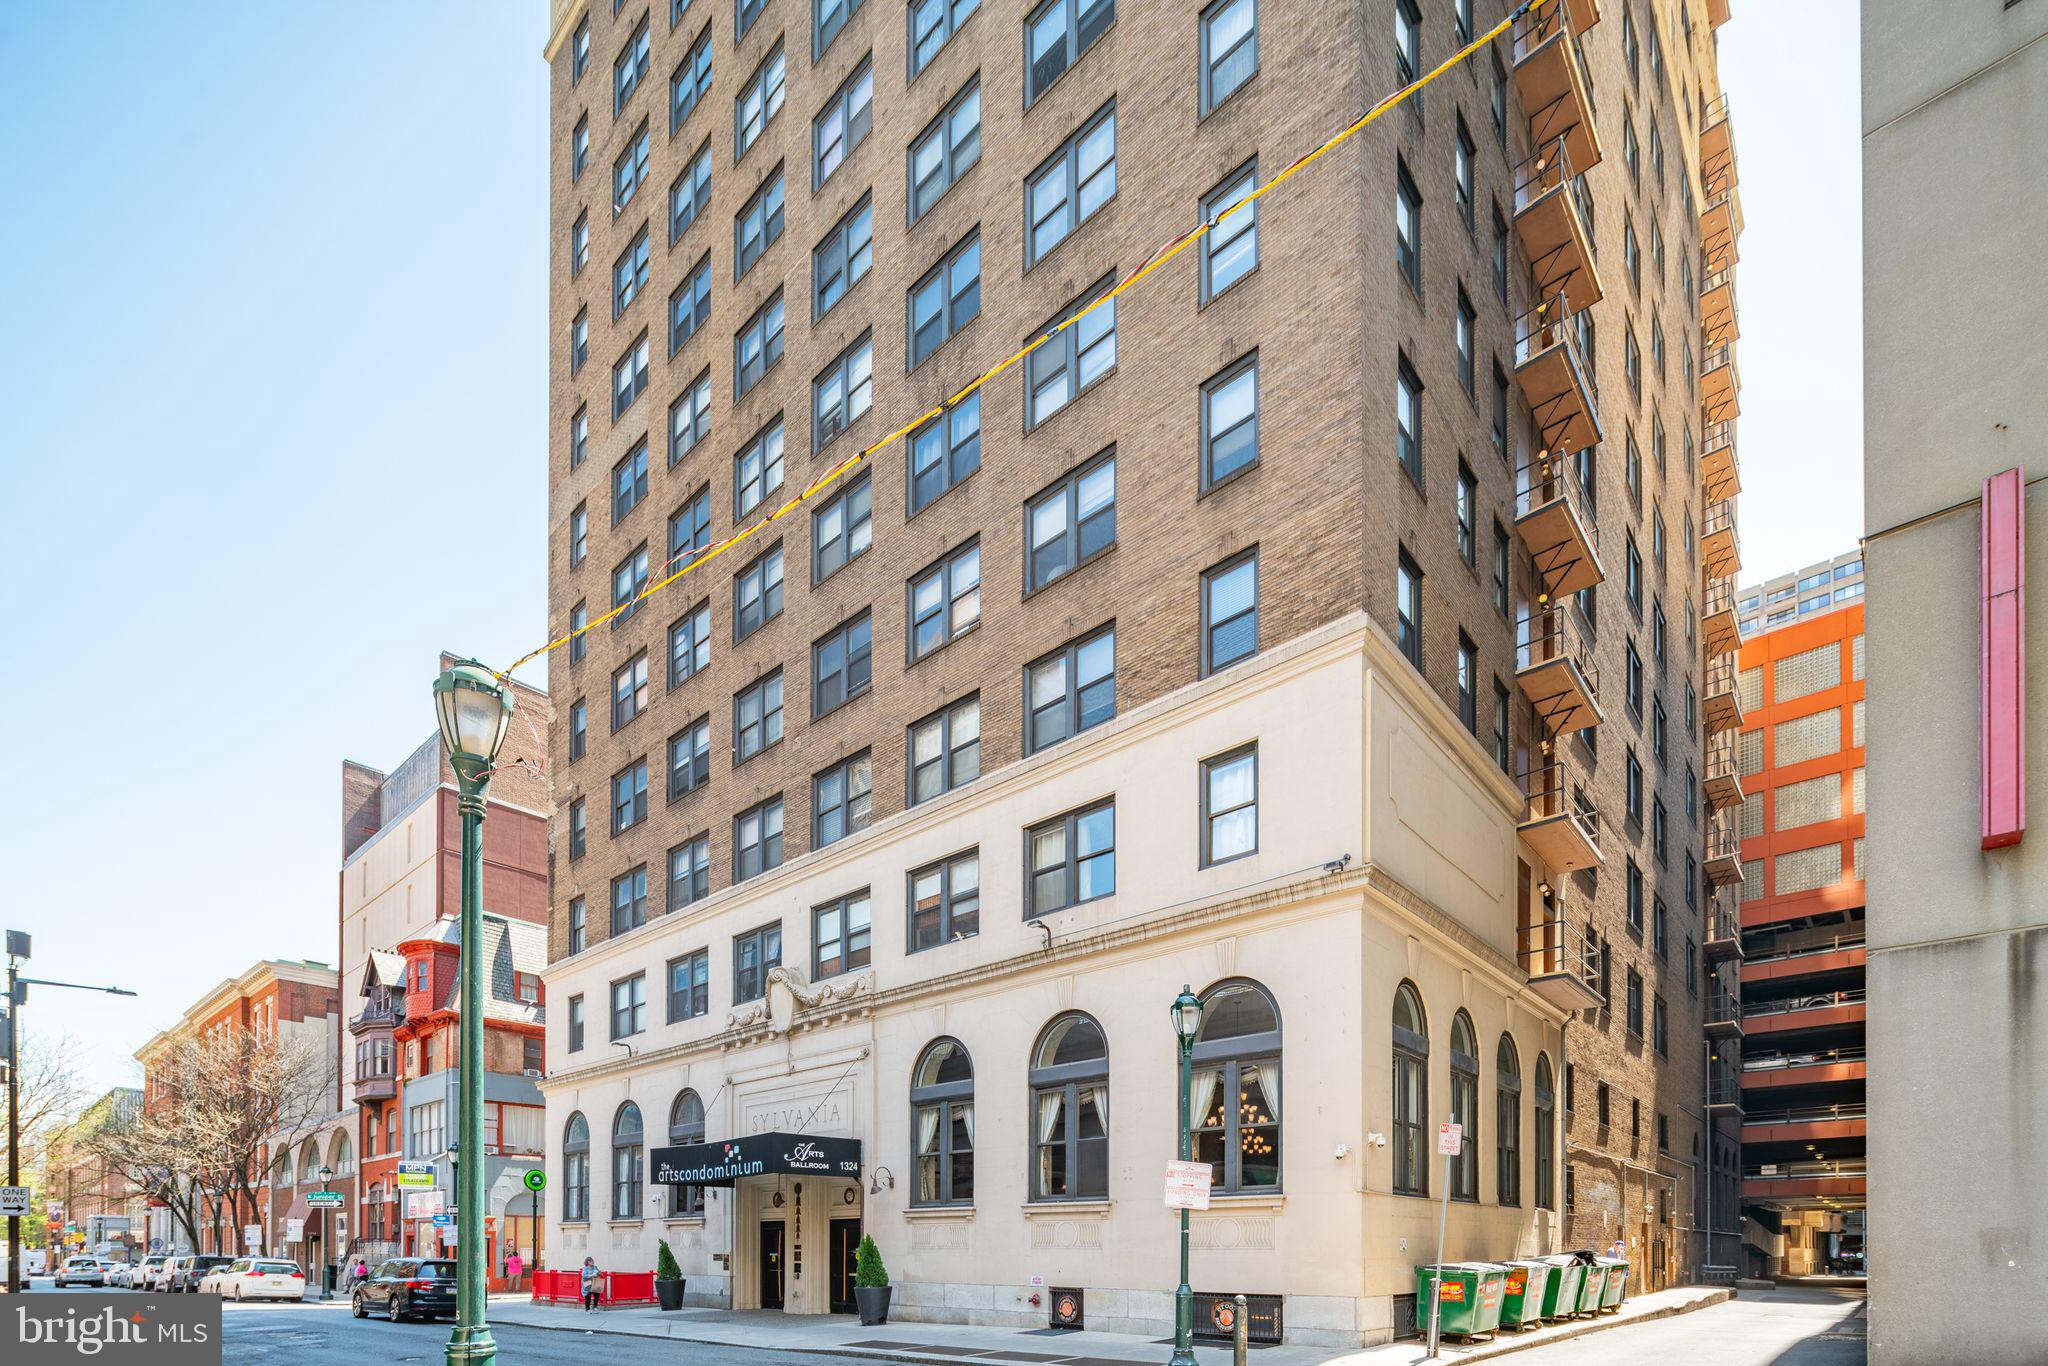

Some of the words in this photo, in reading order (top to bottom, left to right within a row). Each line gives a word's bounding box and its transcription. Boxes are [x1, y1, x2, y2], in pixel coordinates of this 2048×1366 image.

[752, 1103, 840, 1132] SYLVANIA
[405, 1164, 427, 1172] MPN
[661, 1162, 670, 1170] the
[790, 1161, 829, 1170] BALLROOM
[839, 1161, 858, 1171] 1324
[658, 1160, 763, 1182] artscondominium
